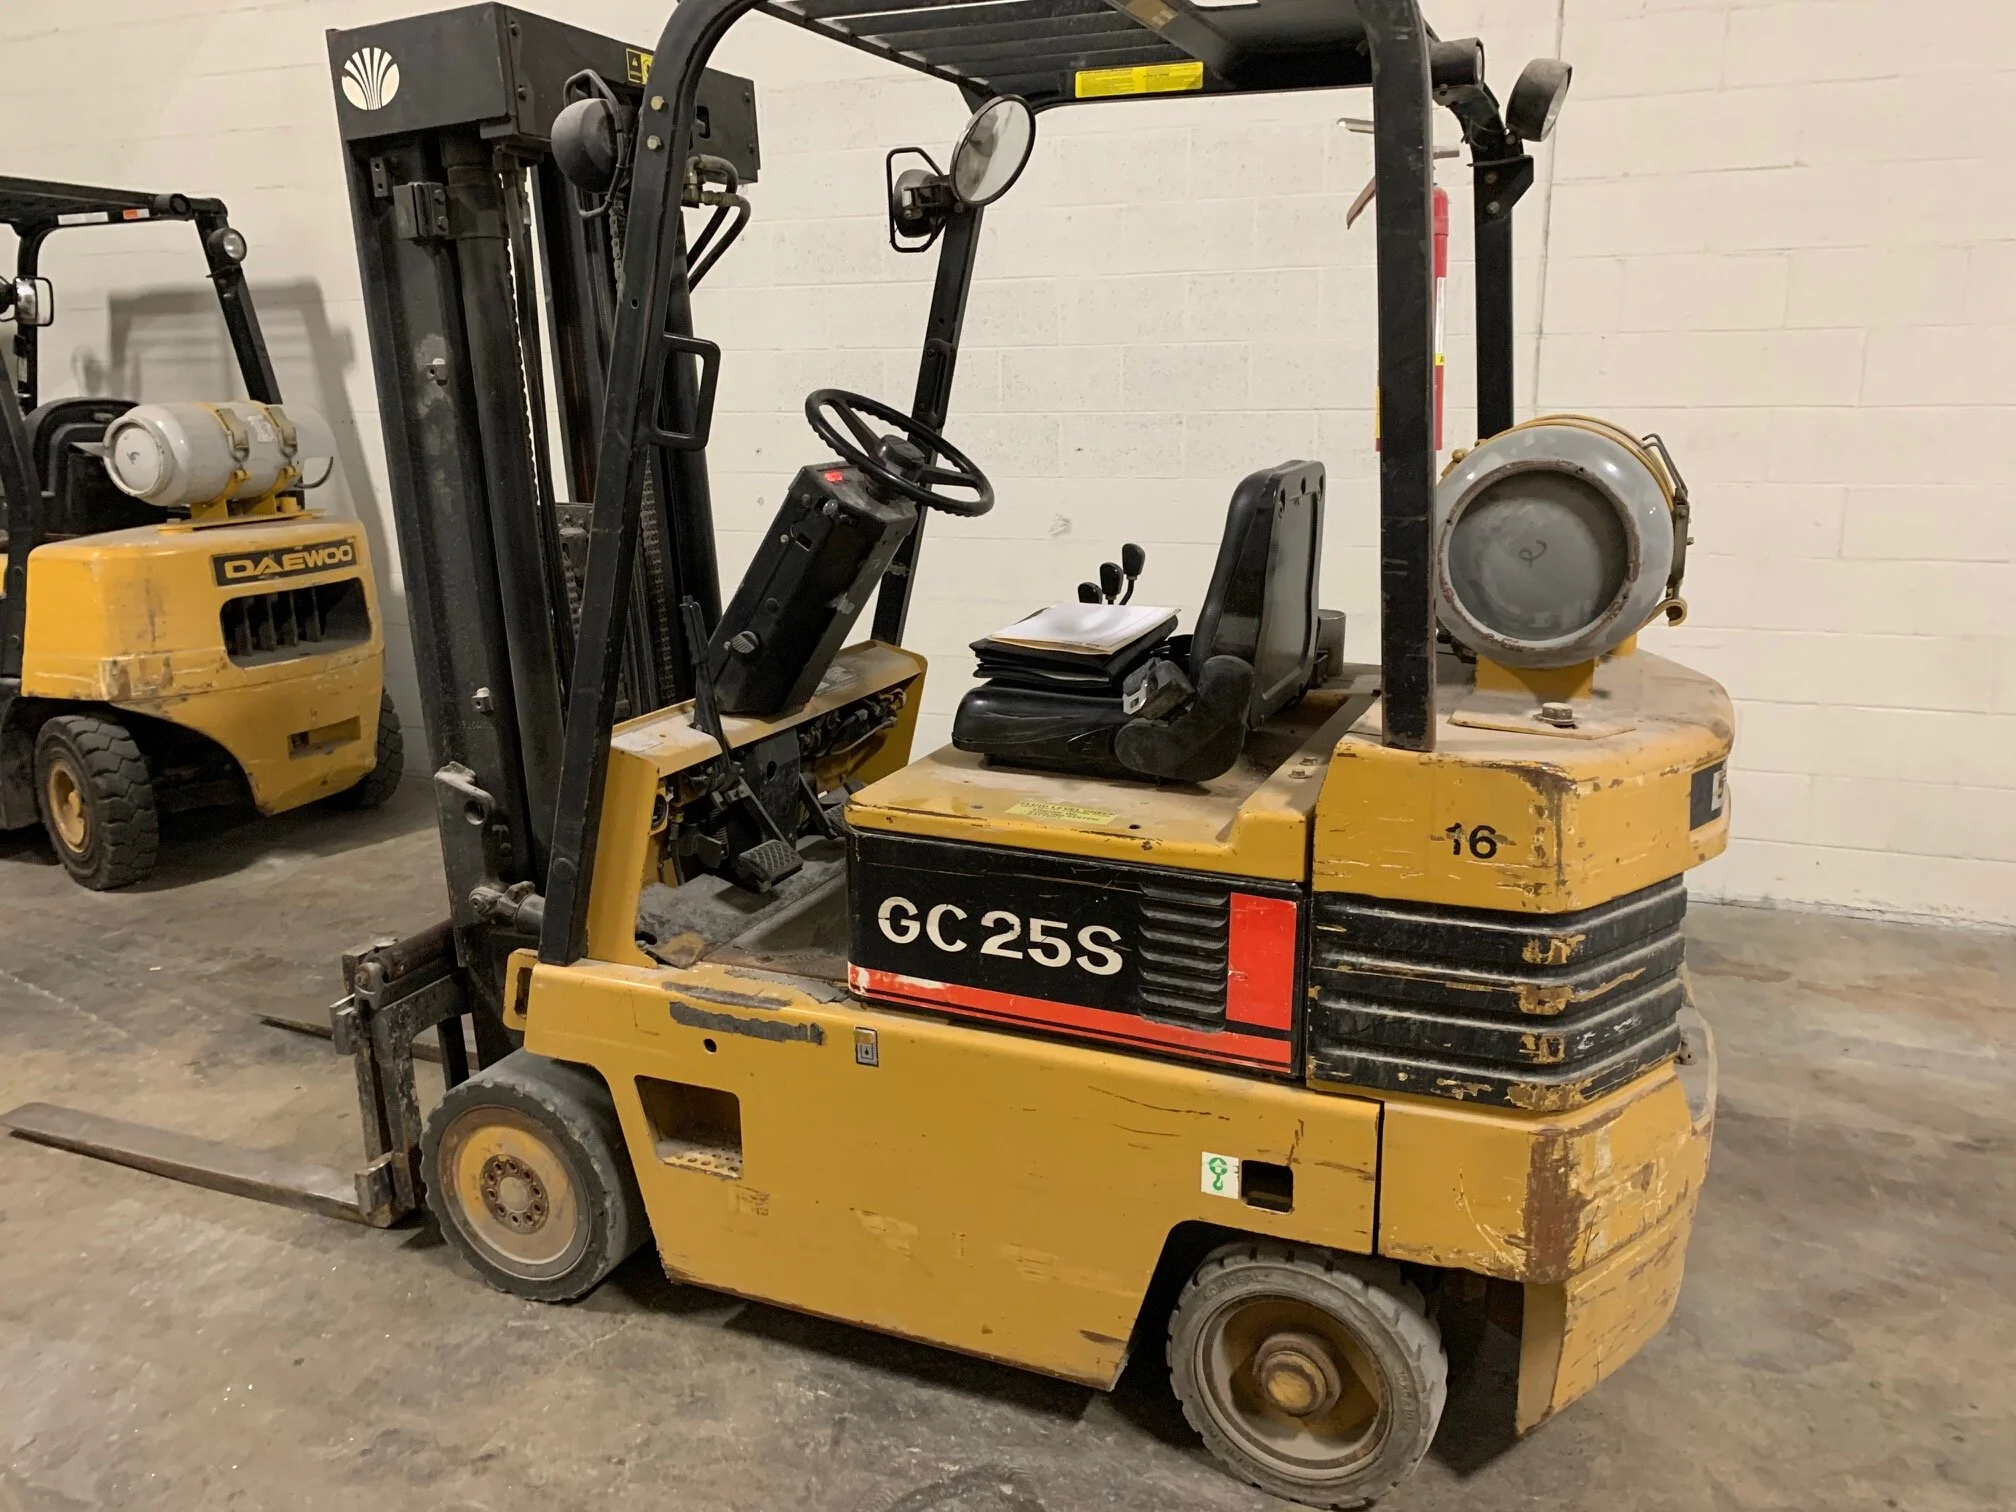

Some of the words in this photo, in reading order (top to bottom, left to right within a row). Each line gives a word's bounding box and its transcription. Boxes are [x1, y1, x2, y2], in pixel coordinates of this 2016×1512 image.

[224, 545, 353, 579] DAEWOO
[1445, 822, 1497, 859] 16
[877, 896, 968, 952] GC
[980, 910, 1123, 976] 25S
